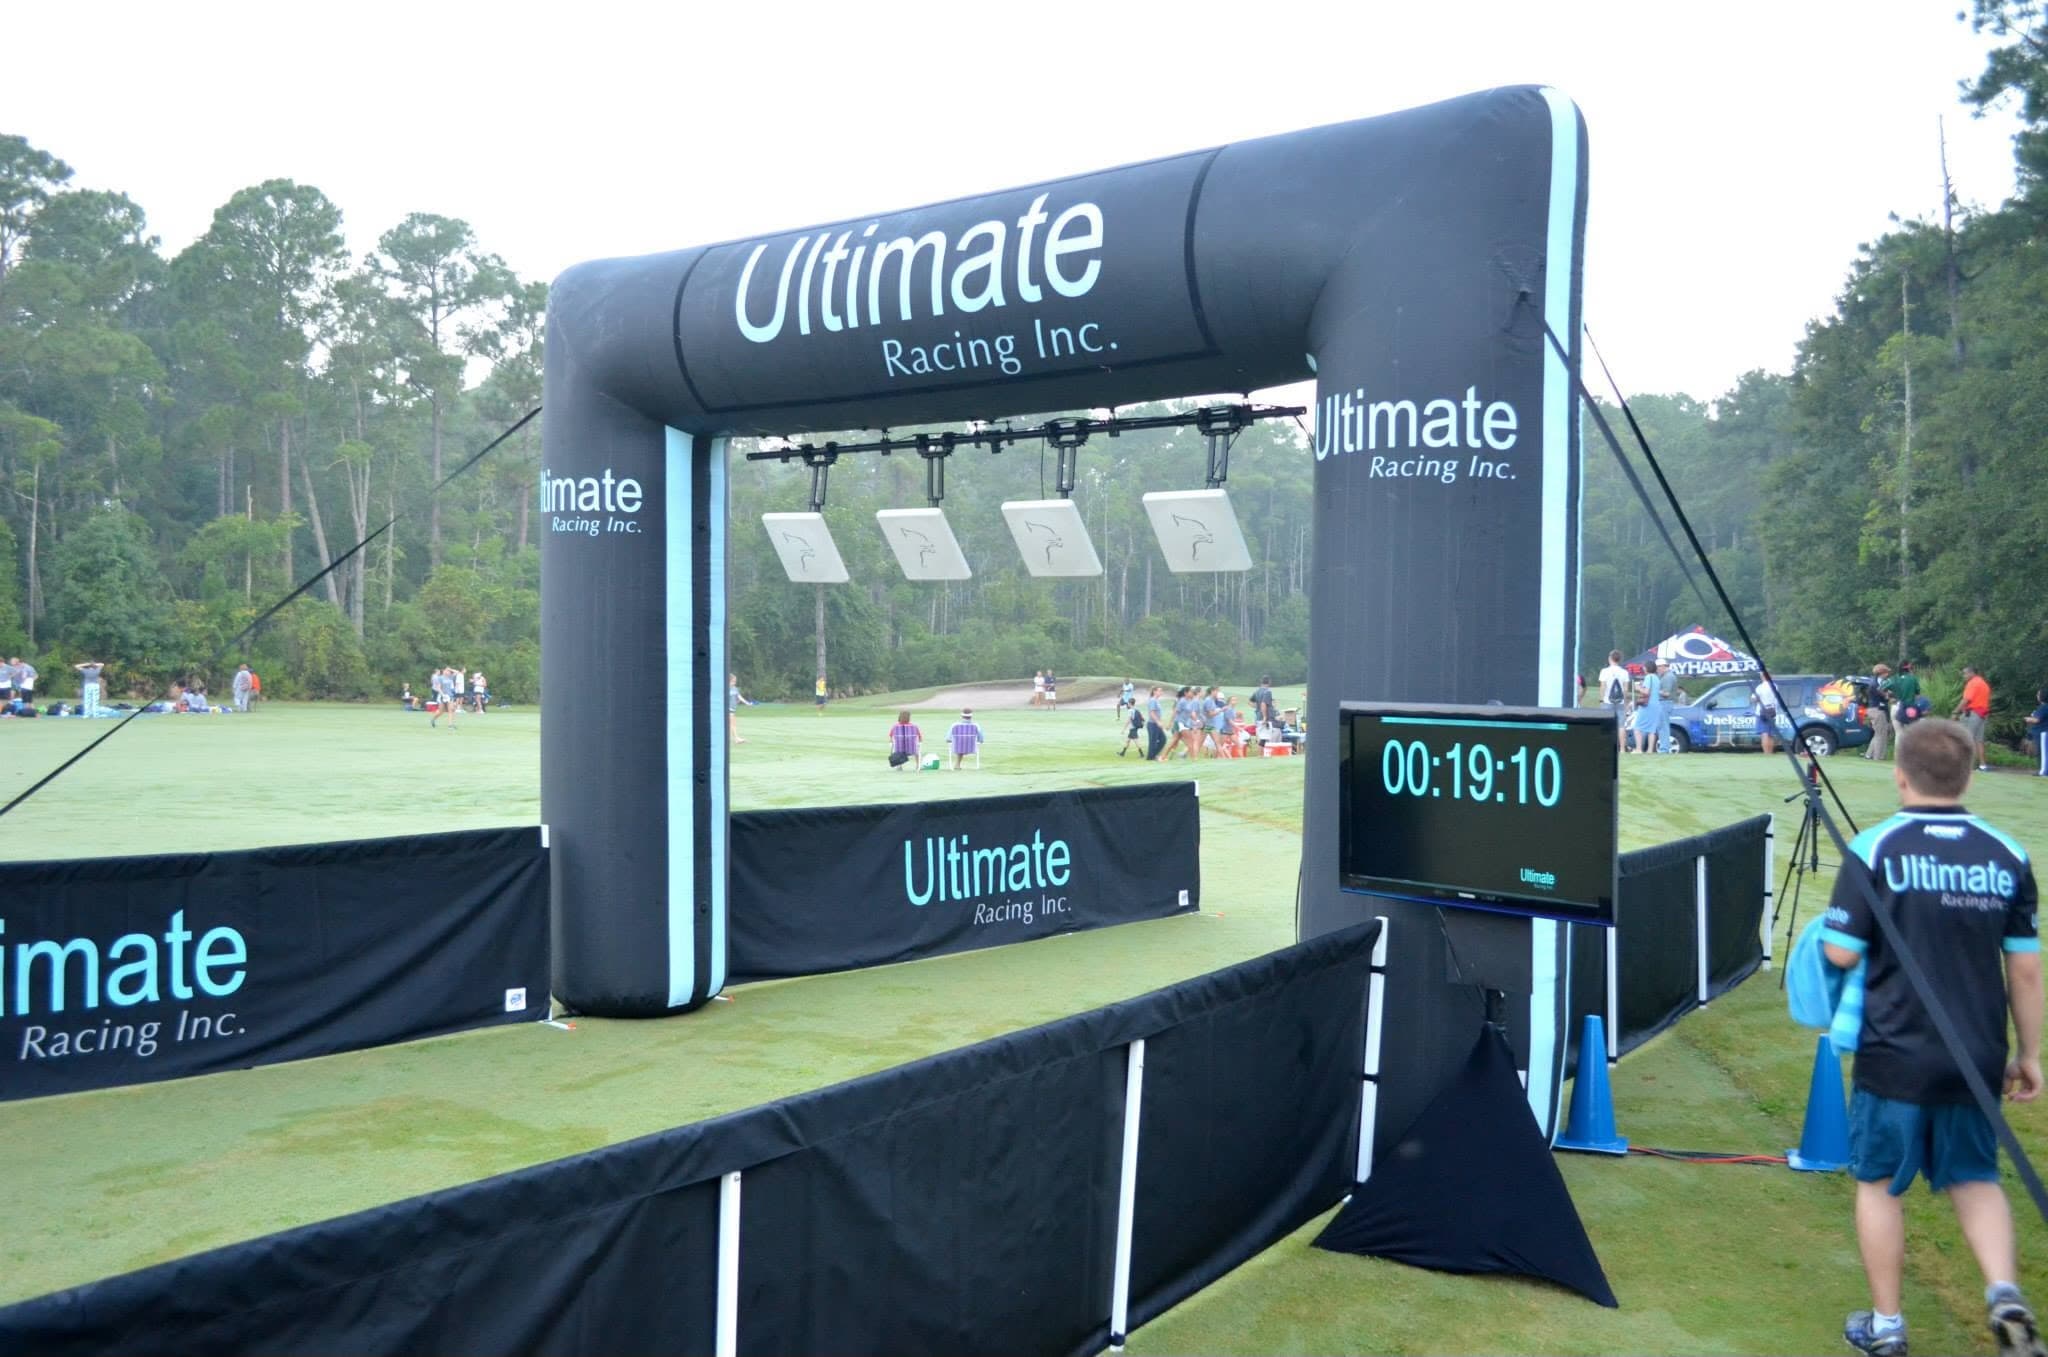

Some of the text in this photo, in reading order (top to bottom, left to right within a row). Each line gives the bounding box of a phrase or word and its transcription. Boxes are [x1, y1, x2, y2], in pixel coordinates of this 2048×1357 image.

[735, 192, 1104, 343] Ultimate
[882, 318, 1118, 376] Racing Inc.
[1316, 385, 1518, 461] Ultimate
[1369, 454, 1517, 484] Racing Inc.
[552, 516, 642, 537] Racing Inc.
[1382, 740, 1562, 807] 00:19:10
[905, 829, 1071, 906] Ultimate
[1520, 868, 1556, 885] Ultimate
[1884, 854, 2015, 898] Ultimate
[974, 894, 1072, 925] Racing Inc.
[1941, 892, 1989, 911] Racing
[20, 1010, 246, 1060] Racing Inc.
